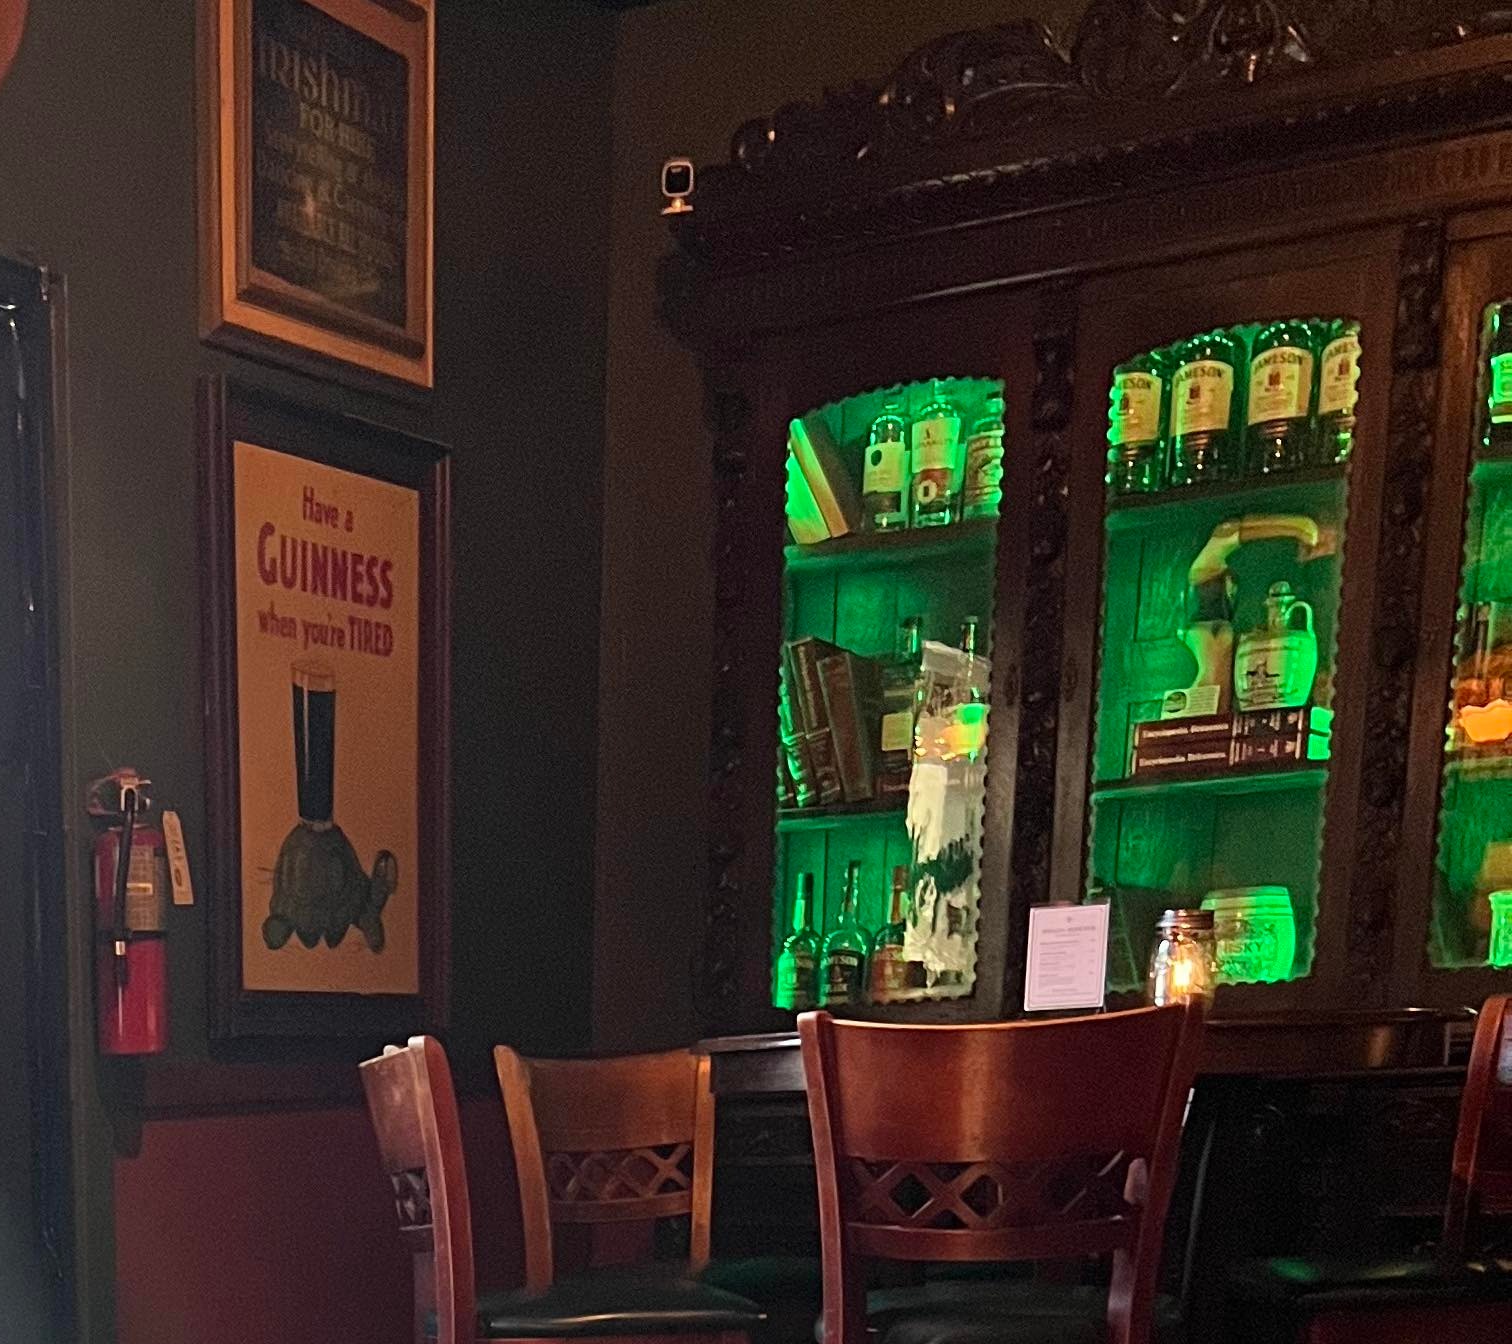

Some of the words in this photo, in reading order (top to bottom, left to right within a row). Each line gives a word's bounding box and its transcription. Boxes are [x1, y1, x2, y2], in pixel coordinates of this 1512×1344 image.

[302, 485, 339, 529] Have
[344, 510, 354, 533] a
[257, 521, 394, 610] GUINNESS
[258, 601, 298, 639] when
[301, 613, 346, 650] you're
[348, 615, 394, 658] TIRED
